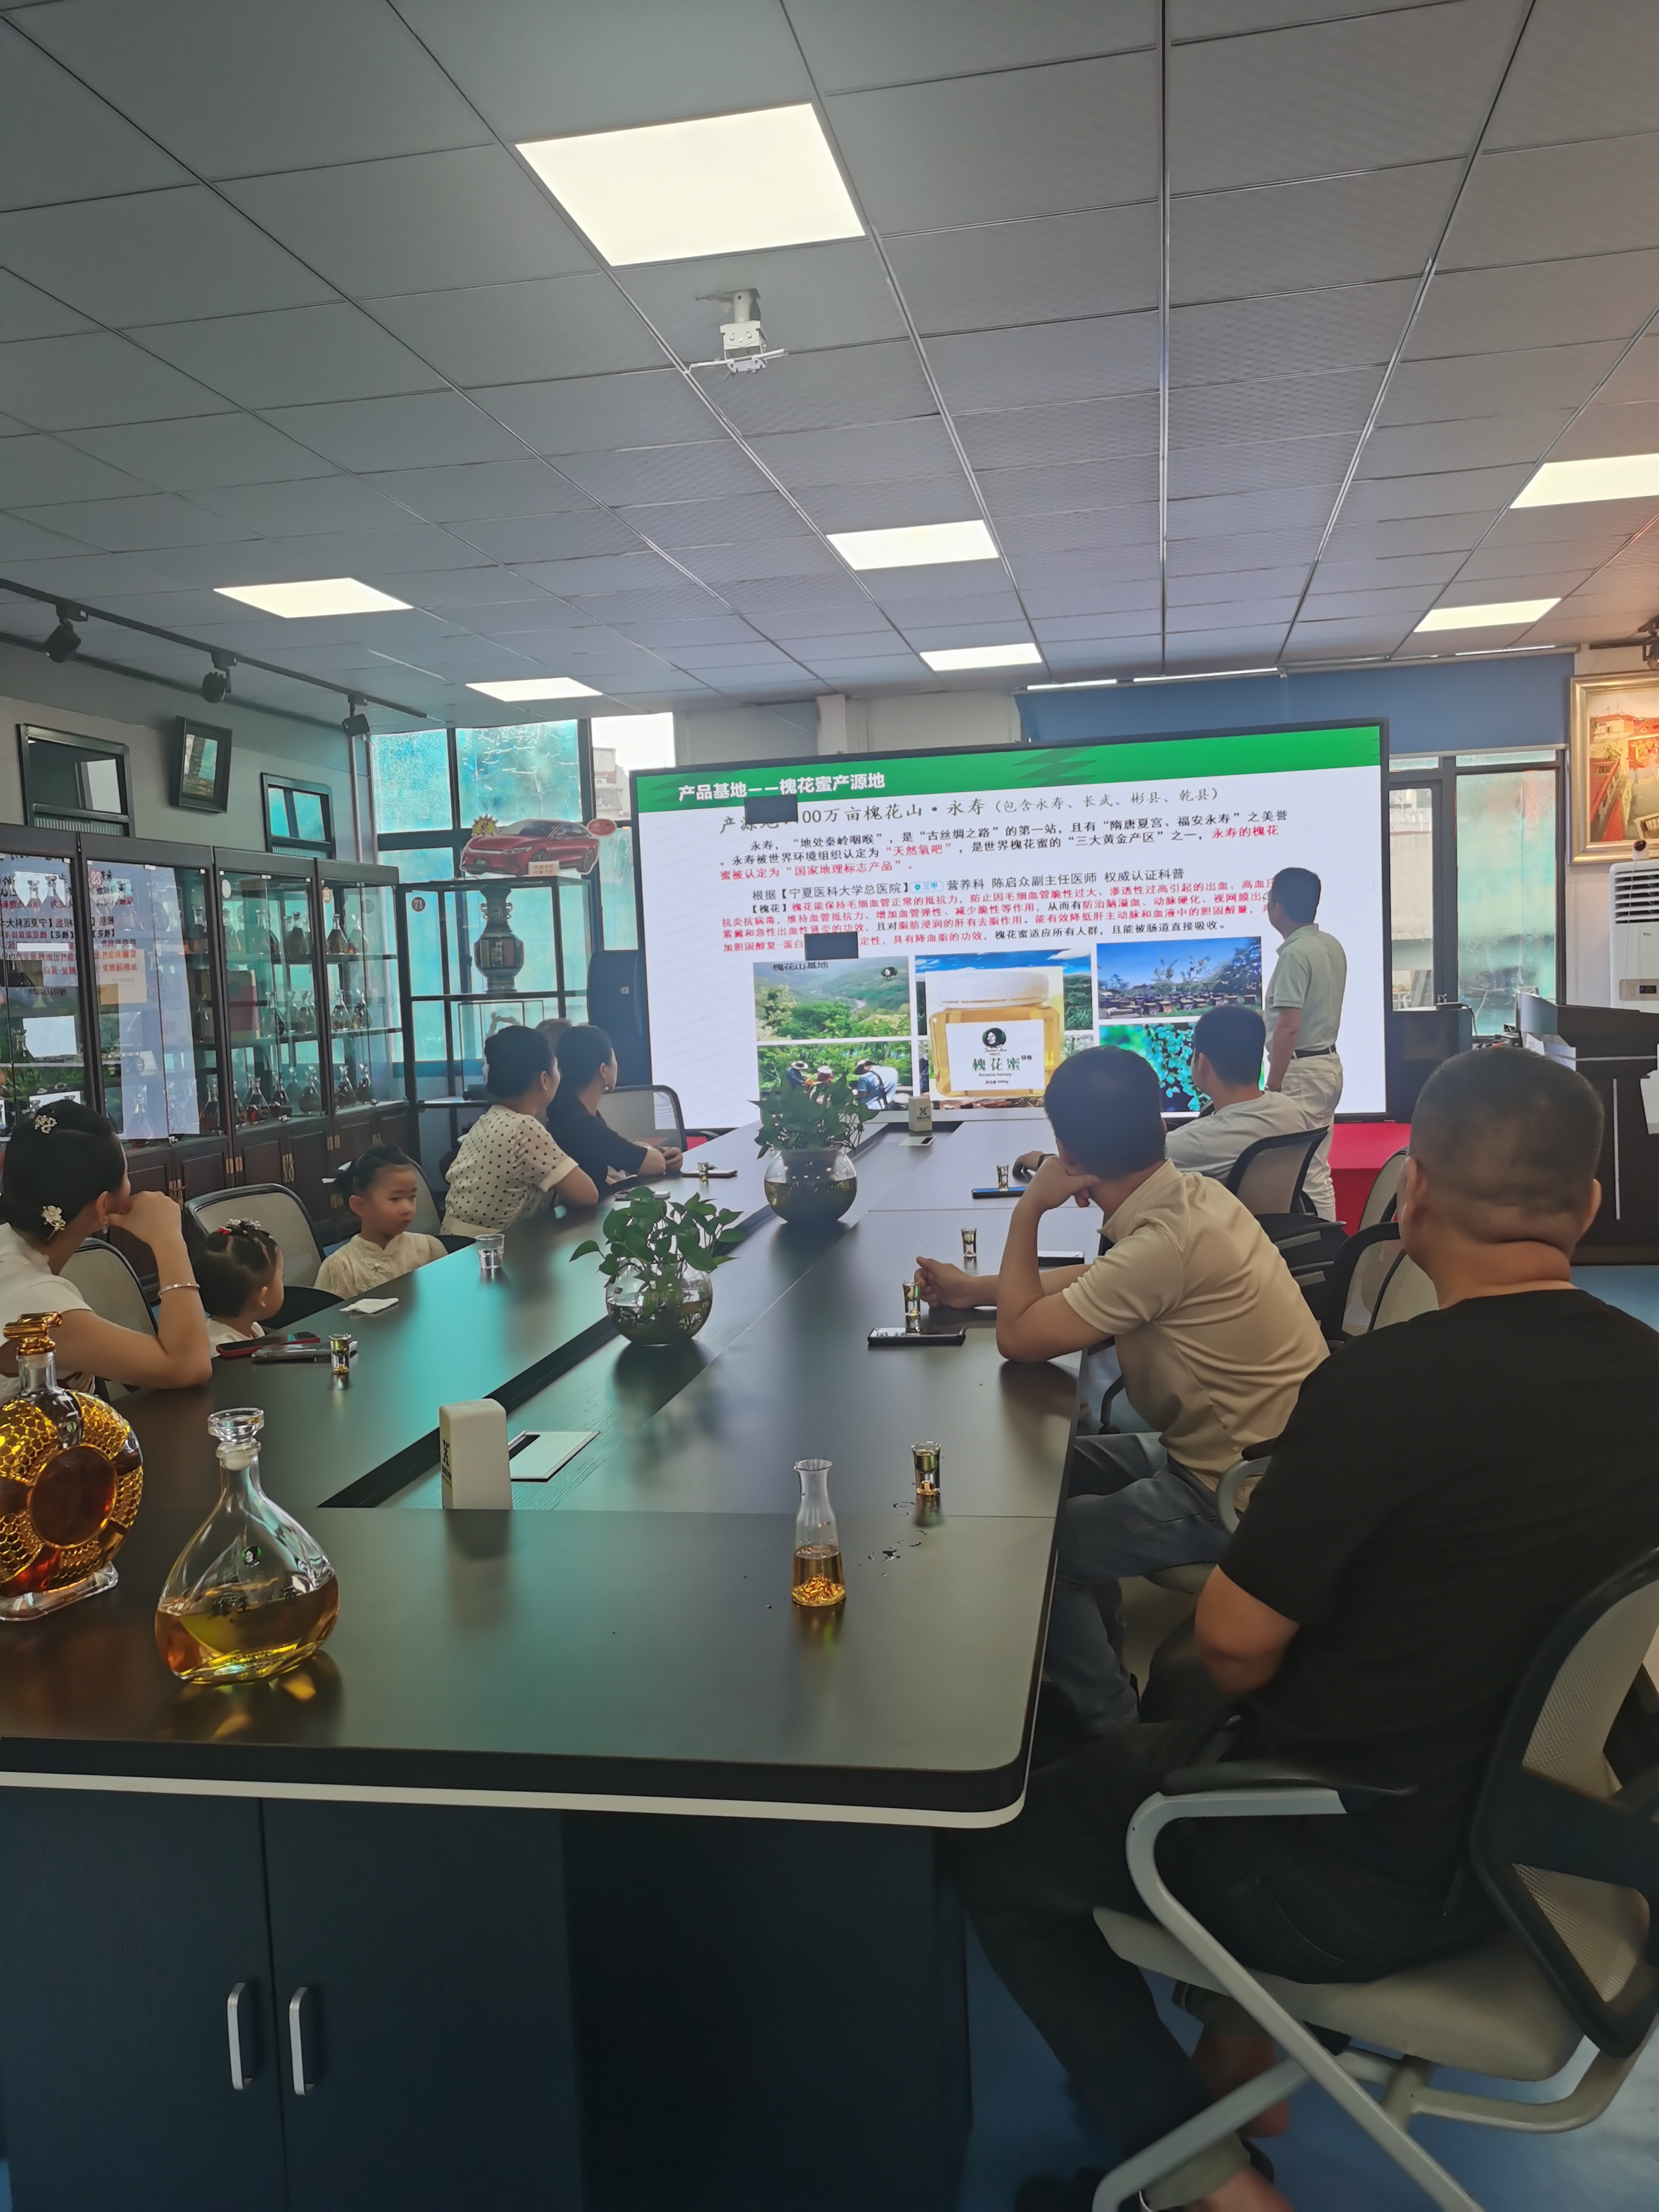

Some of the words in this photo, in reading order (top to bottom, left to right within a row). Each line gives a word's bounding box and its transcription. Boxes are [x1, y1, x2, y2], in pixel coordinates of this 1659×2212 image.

[91, 870, 102, 886] 23
[947, 878, 985, 891] 营养科
[1104, 868, 1185, 883] 权威认证科普
[413, 899, 423, 910] 71
[973, 1057, 1020, 1071] 槐花蜜
